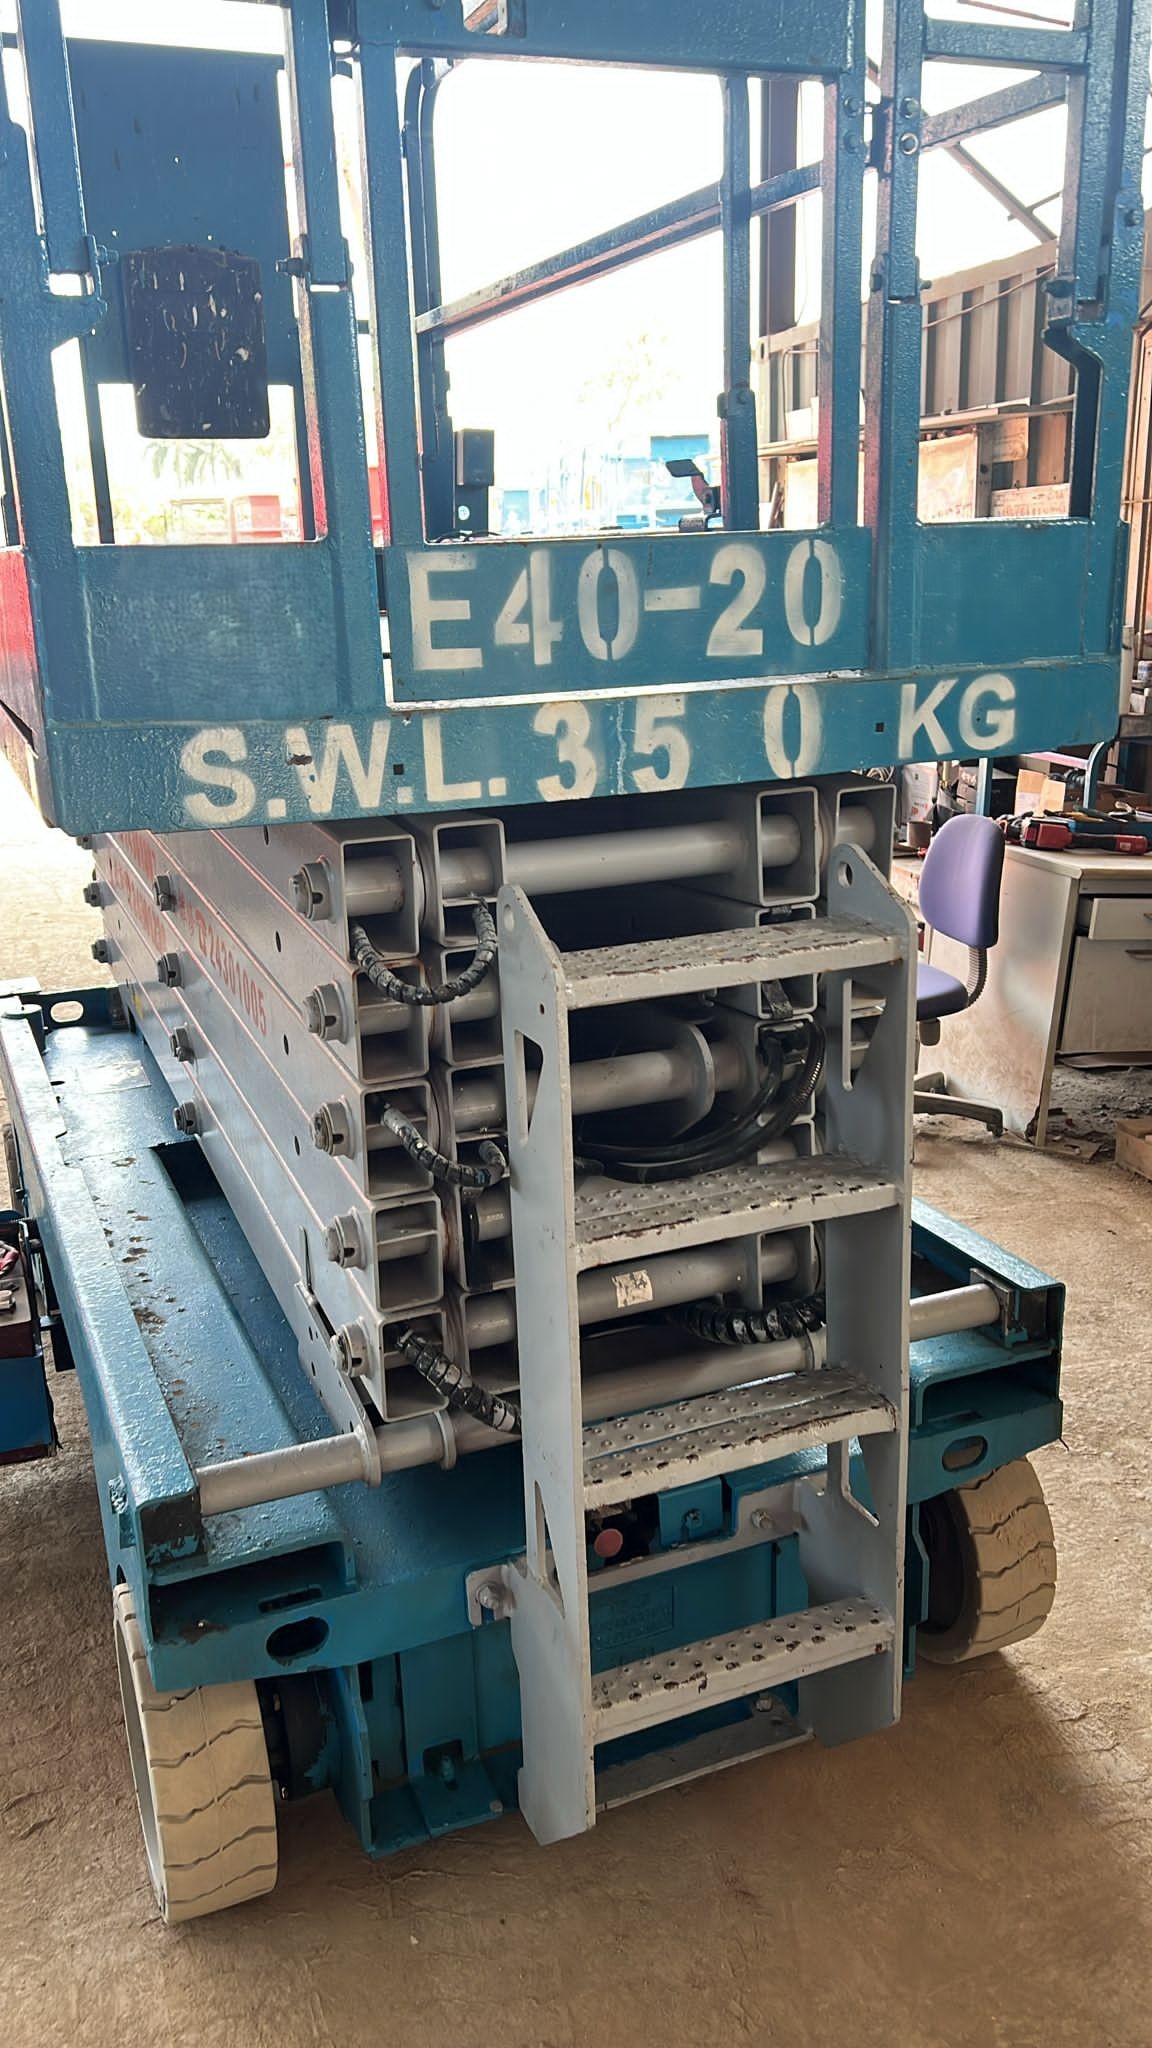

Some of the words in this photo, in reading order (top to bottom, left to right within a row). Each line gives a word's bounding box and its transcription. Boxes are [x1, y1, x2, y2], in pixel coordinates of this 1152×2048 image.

[406, 539, 843, 670] E40-20
[180, 714, 508, 824] S.W.L.
[898, 673, 1016, 759] KG
